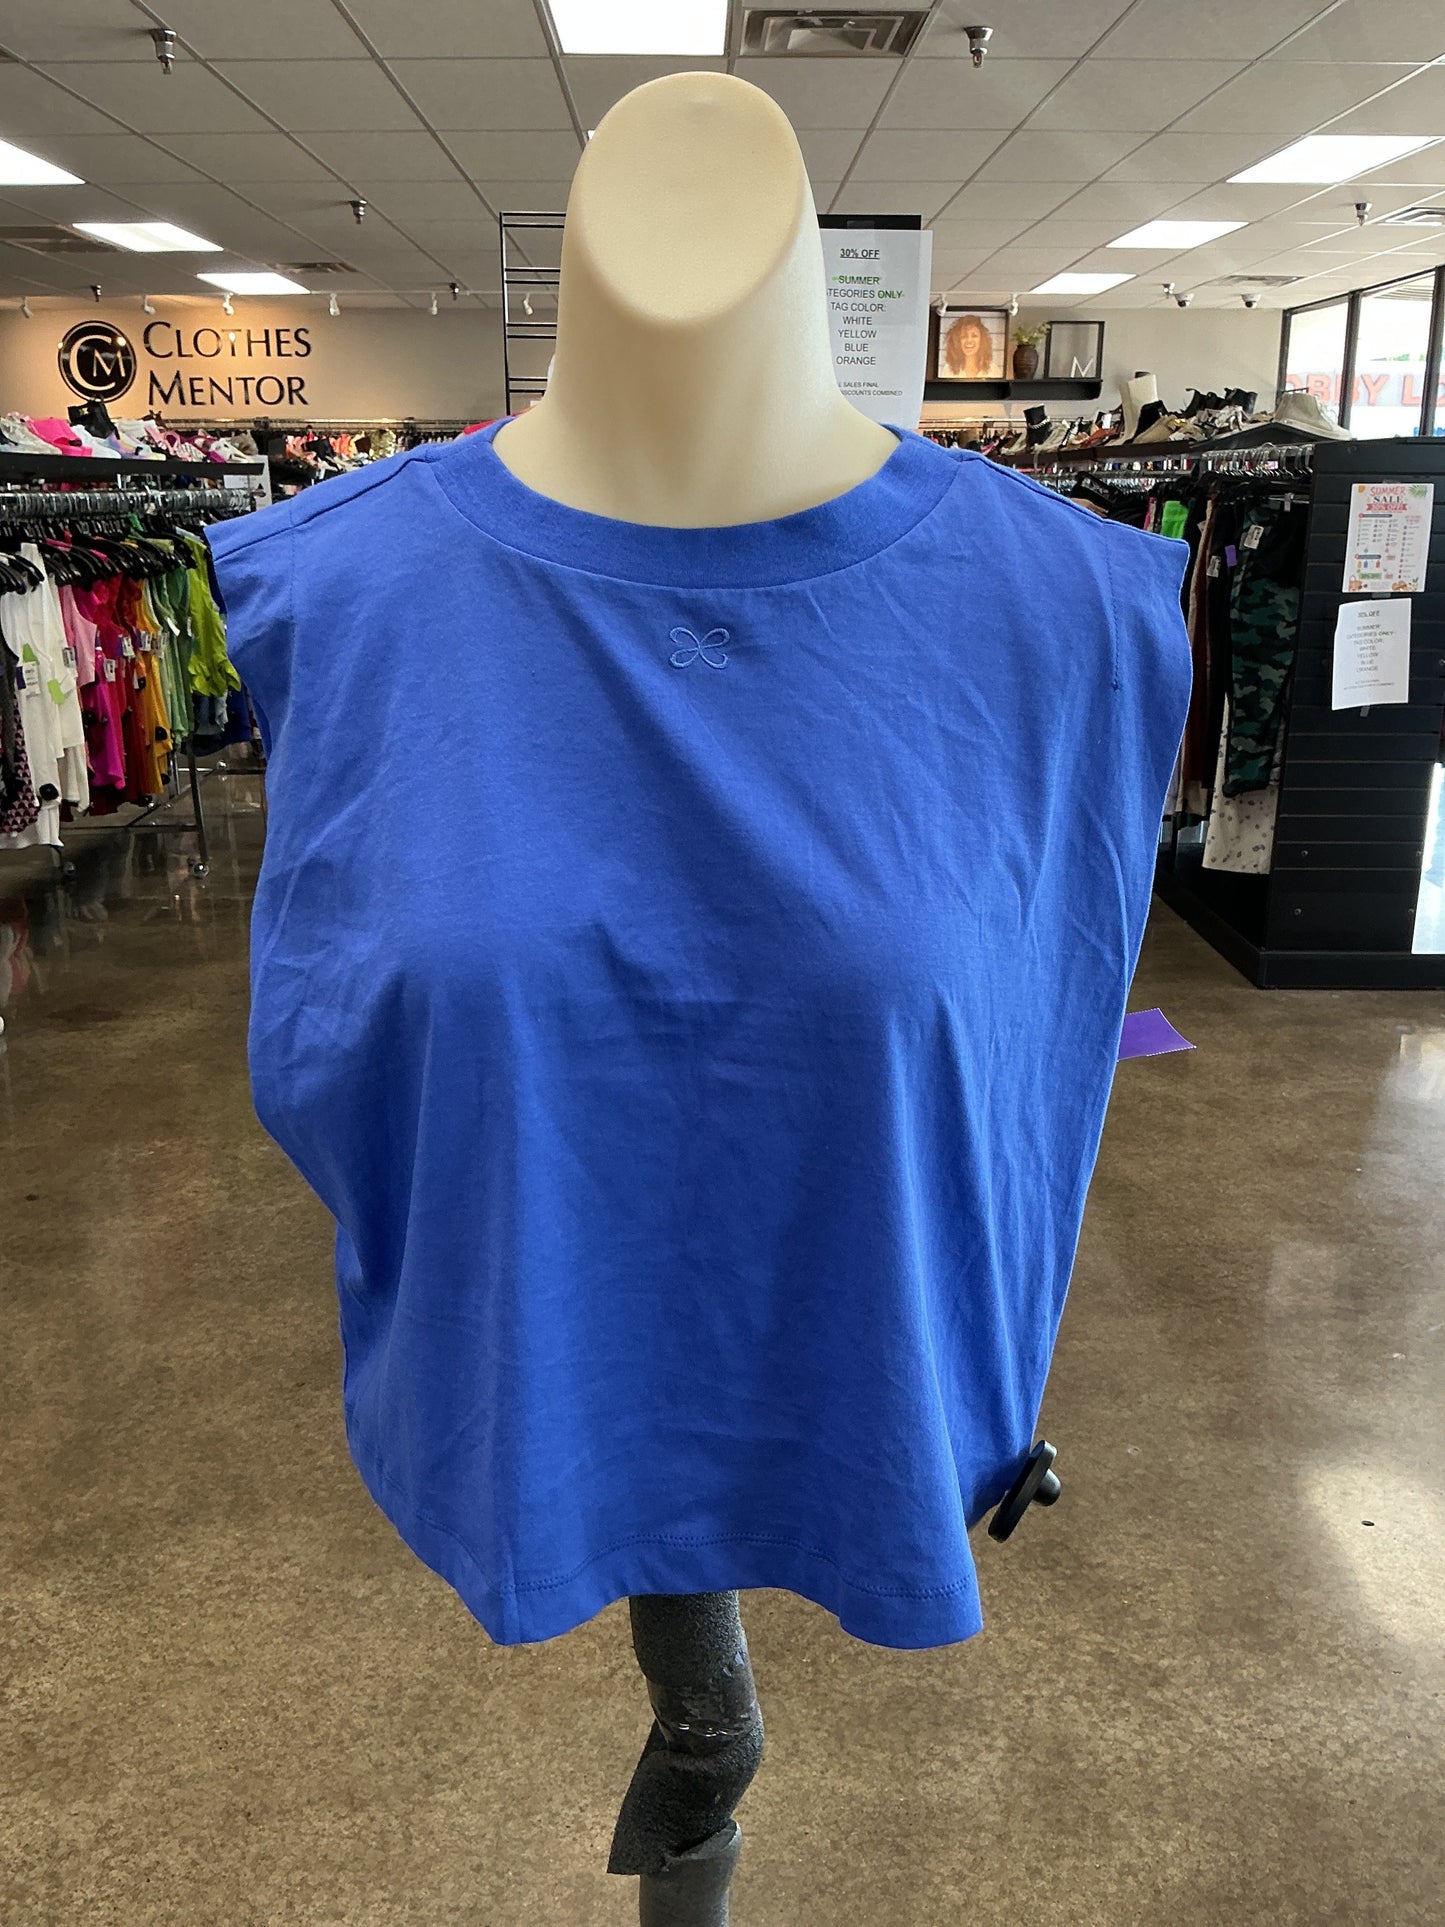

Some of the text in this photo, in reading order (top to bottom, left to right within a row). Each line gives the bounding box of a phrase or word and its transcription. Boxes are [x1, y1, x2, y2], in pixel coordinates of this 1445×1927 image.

[840, 248, 880, 260] 30% OFF
[838, 275, 880, 285] SUMMER
[827, 288, 903, 299] TEGORIES ONLY
[831, 302, 848, 312] TAG
[843, 316, 872, 326] WHITE
[838, 329, 877, 339] YELLOW
[143, 321, 312, 358] CLOTHES
[844, 343, 869, 352] BLUE
[836, 356, 876, 366] ORANGE
[148, 370, 309, 405] MENTOR
[1370, 486, 1406, 498] SUMMER
[1373, 495, 1404, 504] SALE
